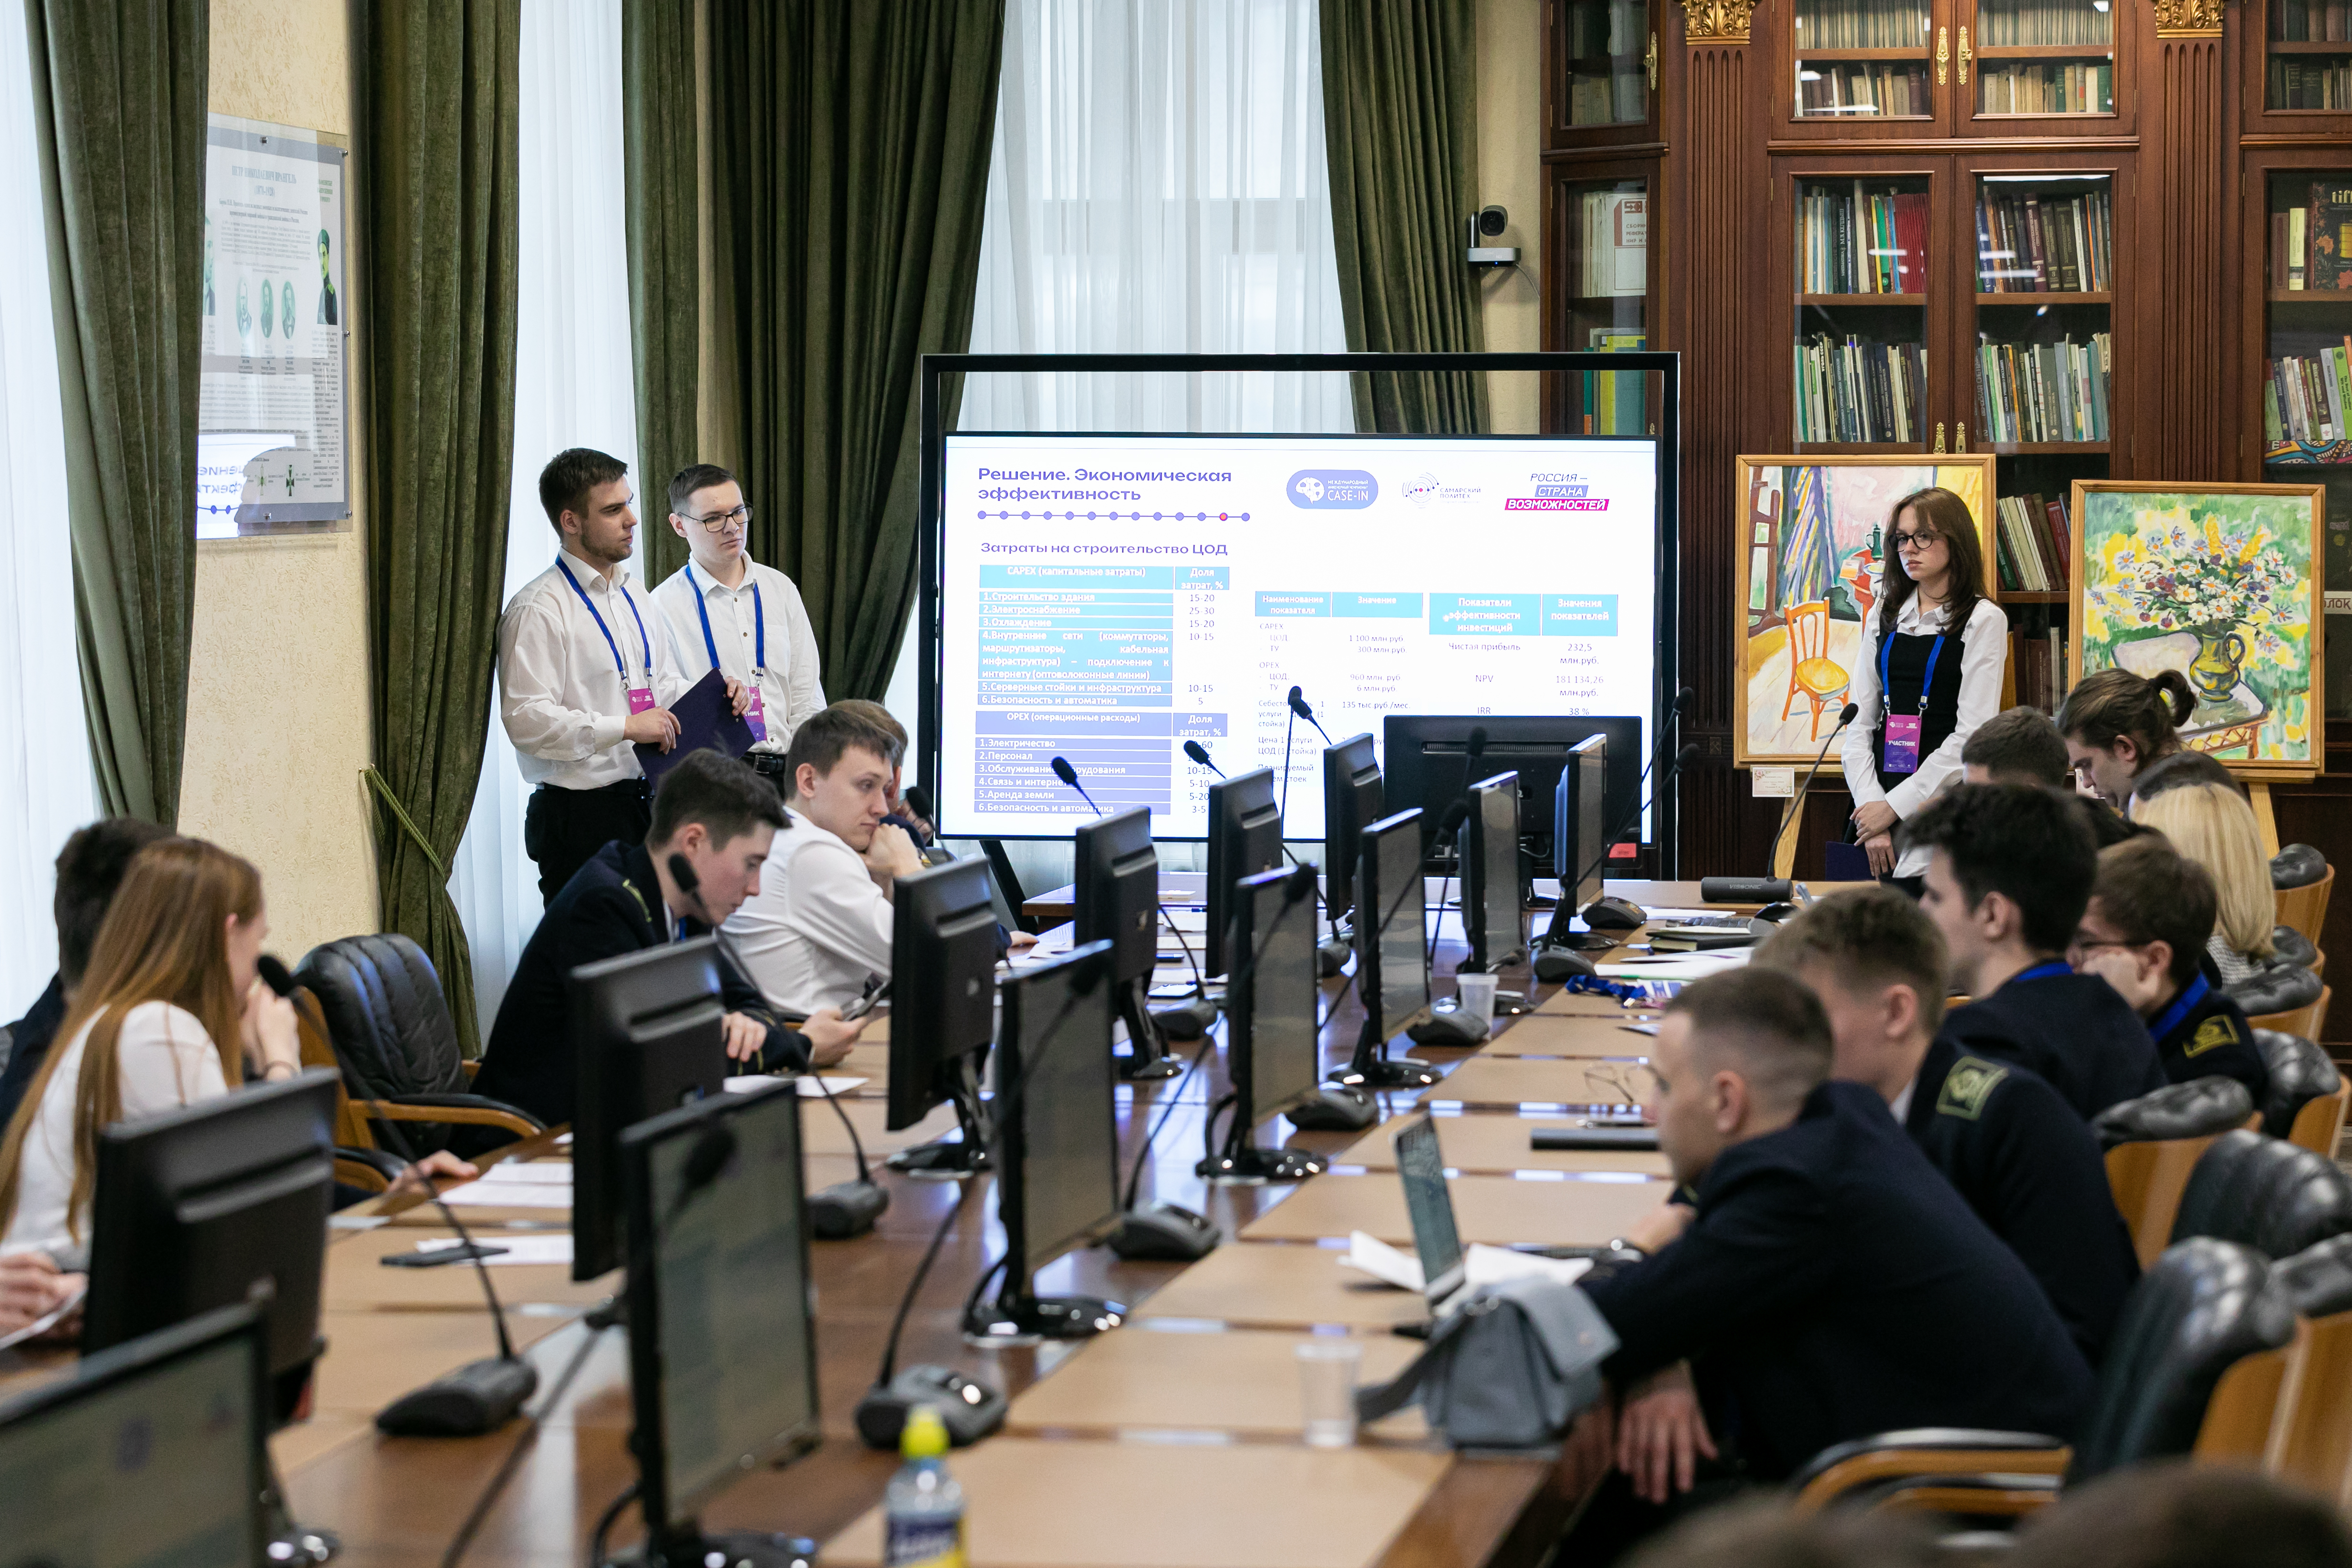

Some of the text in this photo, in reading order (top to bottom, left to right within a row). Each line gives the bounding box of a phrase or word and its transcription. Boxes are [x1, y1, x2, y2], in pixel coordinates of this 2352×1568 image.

[978, 468, 1232, 482] Решение. Экономическая
[1530, 473, 1577, 482] РОССИЯ
[978, 487, 1141, 502] эффективность
[1327, 490, 1368, 501] CASE-IN
[1537, 487, 1584, 497] СТРАНА
[1508, 498, 1606, 510] ВОЗМОЖНОСТЕЙ
[981, 543, 1047, 554] Затраты
[1073, 545, 1189, 555] строительство
[1193, 544, 1228, 555] ЦОД
[1006, 566, 1146, 577] CAPEX (капитальные затраты)
[1190, 568, 1214, 578] Доля
[1181, 581, 1224, 590] затрат, %
[983, 592, 1096, 602] 1.Строительство здания
[1262, 595, 1324, 603] Наименование
[1357, 596, 1397, 604] Значение
[1458, 597, 1512, 607] Показатели
[1558, 598, 1603, 607] Значения
[983, 604, 1081, 615] 2.Электроснабжение
[1449, 611, 1521, 621] эффективности
[1550, 611, 1609, 621] показателей
[983, 617, 1052, 628] 3.Охлаждение
[1457, 623, 1513, 633] инвестиций
[982, 630, 1047, 641] 4.Внутренние
[1098, 631, 1169, 642] (коммутаторы,
[1371, 635, 1405, 643] млн.руб.
[982, 644, 1169, 654] маршрутизаторы, кабельная
[1373, 646, 1407, 654] млн.руб.
[1449, 643, 1521, 651] Чистая прибыль
[1567, 644, 1592, 653] 232,5
[982, 656, 1061, 667] инфраструктура)
[1087, 658, 1153, 668] подключение
[1560, 656, 1599, 665] млн.руб.
[982, 669, 1150, 681] интернету (оптоволоконные линии)
[1574, 676, 1604, 685] 134,26
[982, 682, 1043, 693] 5.Серверные
[1044, 683, 1077, 692] стойки
[1087, 683, 1162, 694] инфраструктура
[1560, 689, 1599, 697] млн.руб.
[981, 695, 1053, 705] 6.Безопасность
[1063, 696, 1118, 705] автоматика
[1358, 701, 1410, 709] тыс.руб./мес.
[1582, 708, 1589, 716] %
[1006, 712, 1140, 723] OPEX (операционные расходы)
[1188, 715, 1213, 725] Доля
[1179, 727, 1222, 737] затрат, %
[979, 738, 1056, 749] 1.Электричество
[979, 751, 1033, 761] 2.Персонал
[979, 777, 1013, 786] 4.Связь
[979, 790, 1023, 800] 5.Аренда
[978, 803, 1049, 812] 6.Безопасность
